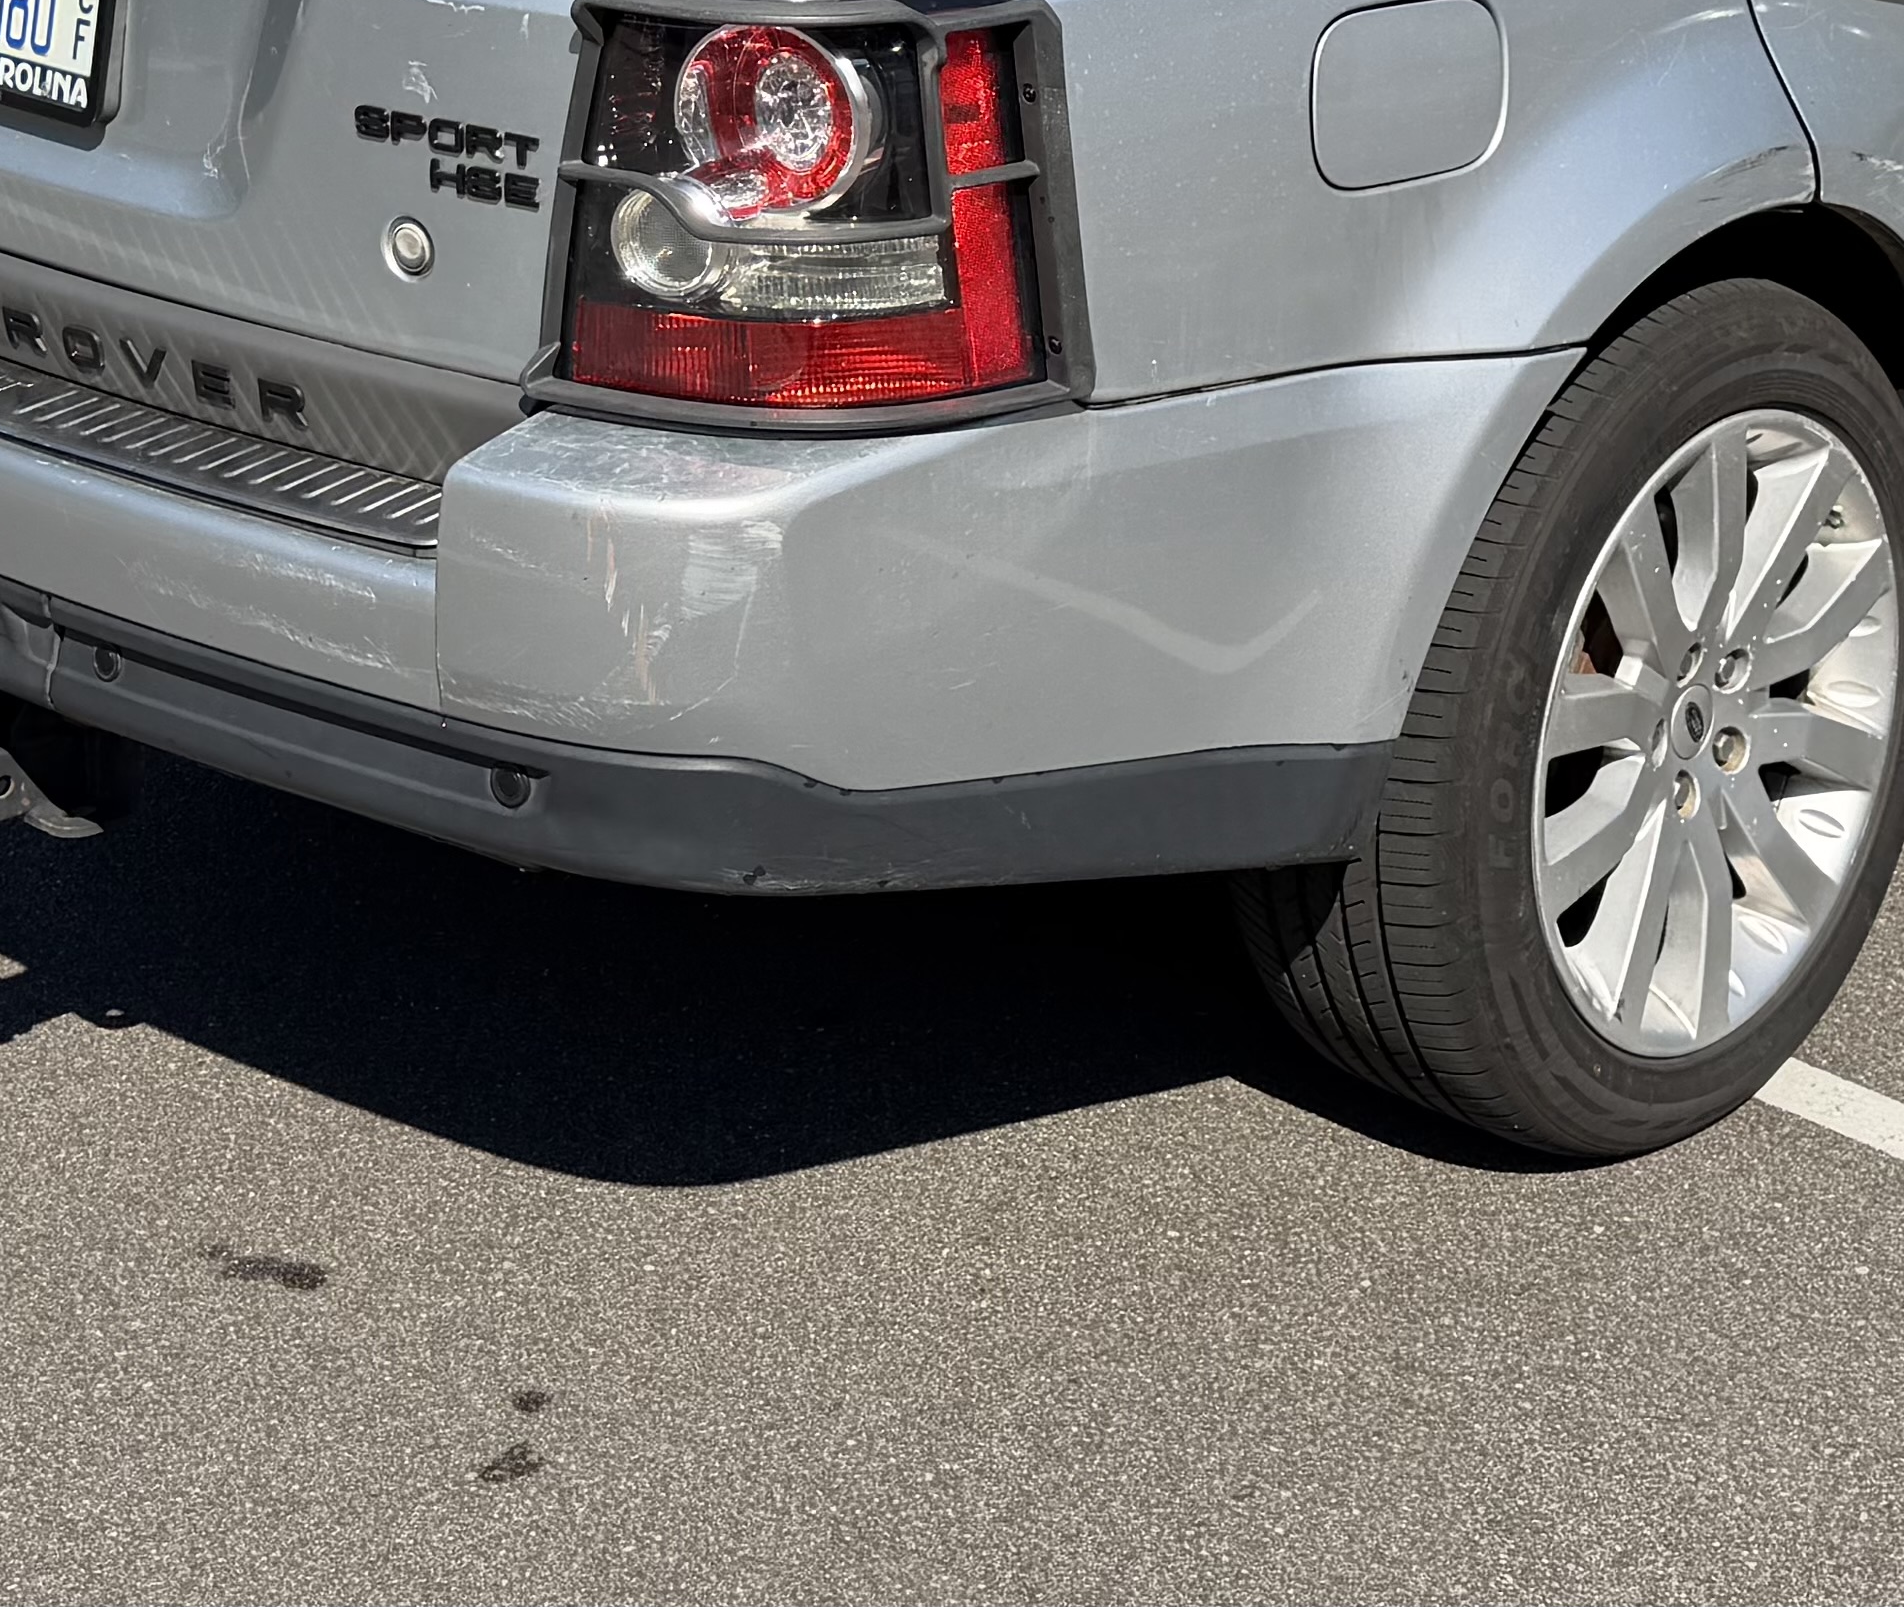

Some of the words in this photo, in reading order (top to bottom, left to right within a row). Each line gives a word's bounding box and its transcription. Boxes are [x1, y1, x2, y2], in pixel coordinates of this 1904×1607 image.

[72, 18, 91, 60] F
[354, 105, 540, 170] SPORT
[430, 158, 542, 213] HSE
[1, 306, 310, 430] ROVER
